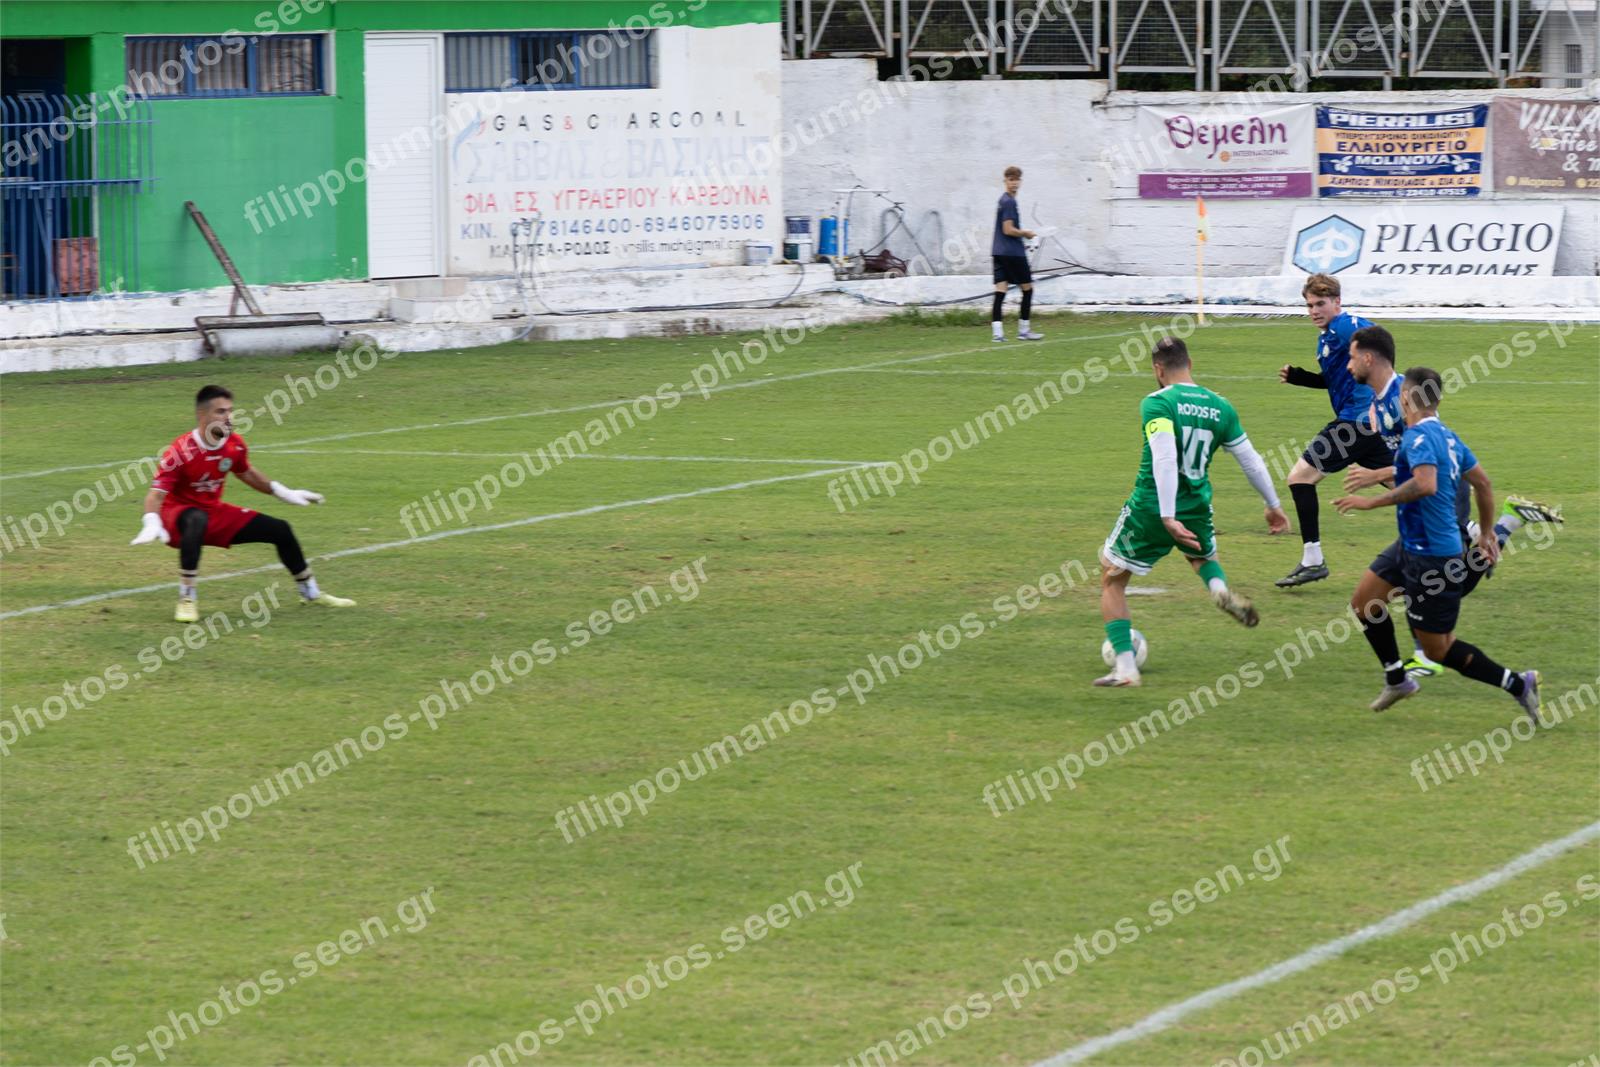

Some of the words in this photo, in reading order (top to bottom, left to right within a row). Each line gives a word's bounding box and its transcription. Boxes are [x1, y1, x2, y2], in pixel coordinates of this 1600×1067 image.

[1328, 111, 1475, 127] PIERALISI
[1337, 140, 1467, 153] ΕΛΑΙΟΥΡΓΕΙΟ
[1354, 155, 1452, 165] MOLINOVA
[464, 191, 538, 213] ΦΙΑΕΣ
[1371, 222, 1554, 252] PIAGGIO
[1177, 402, 1209, 418] RODOS
[1209, 406, 1221, 421] FC
[1178, 425, 1214, 480] 10
